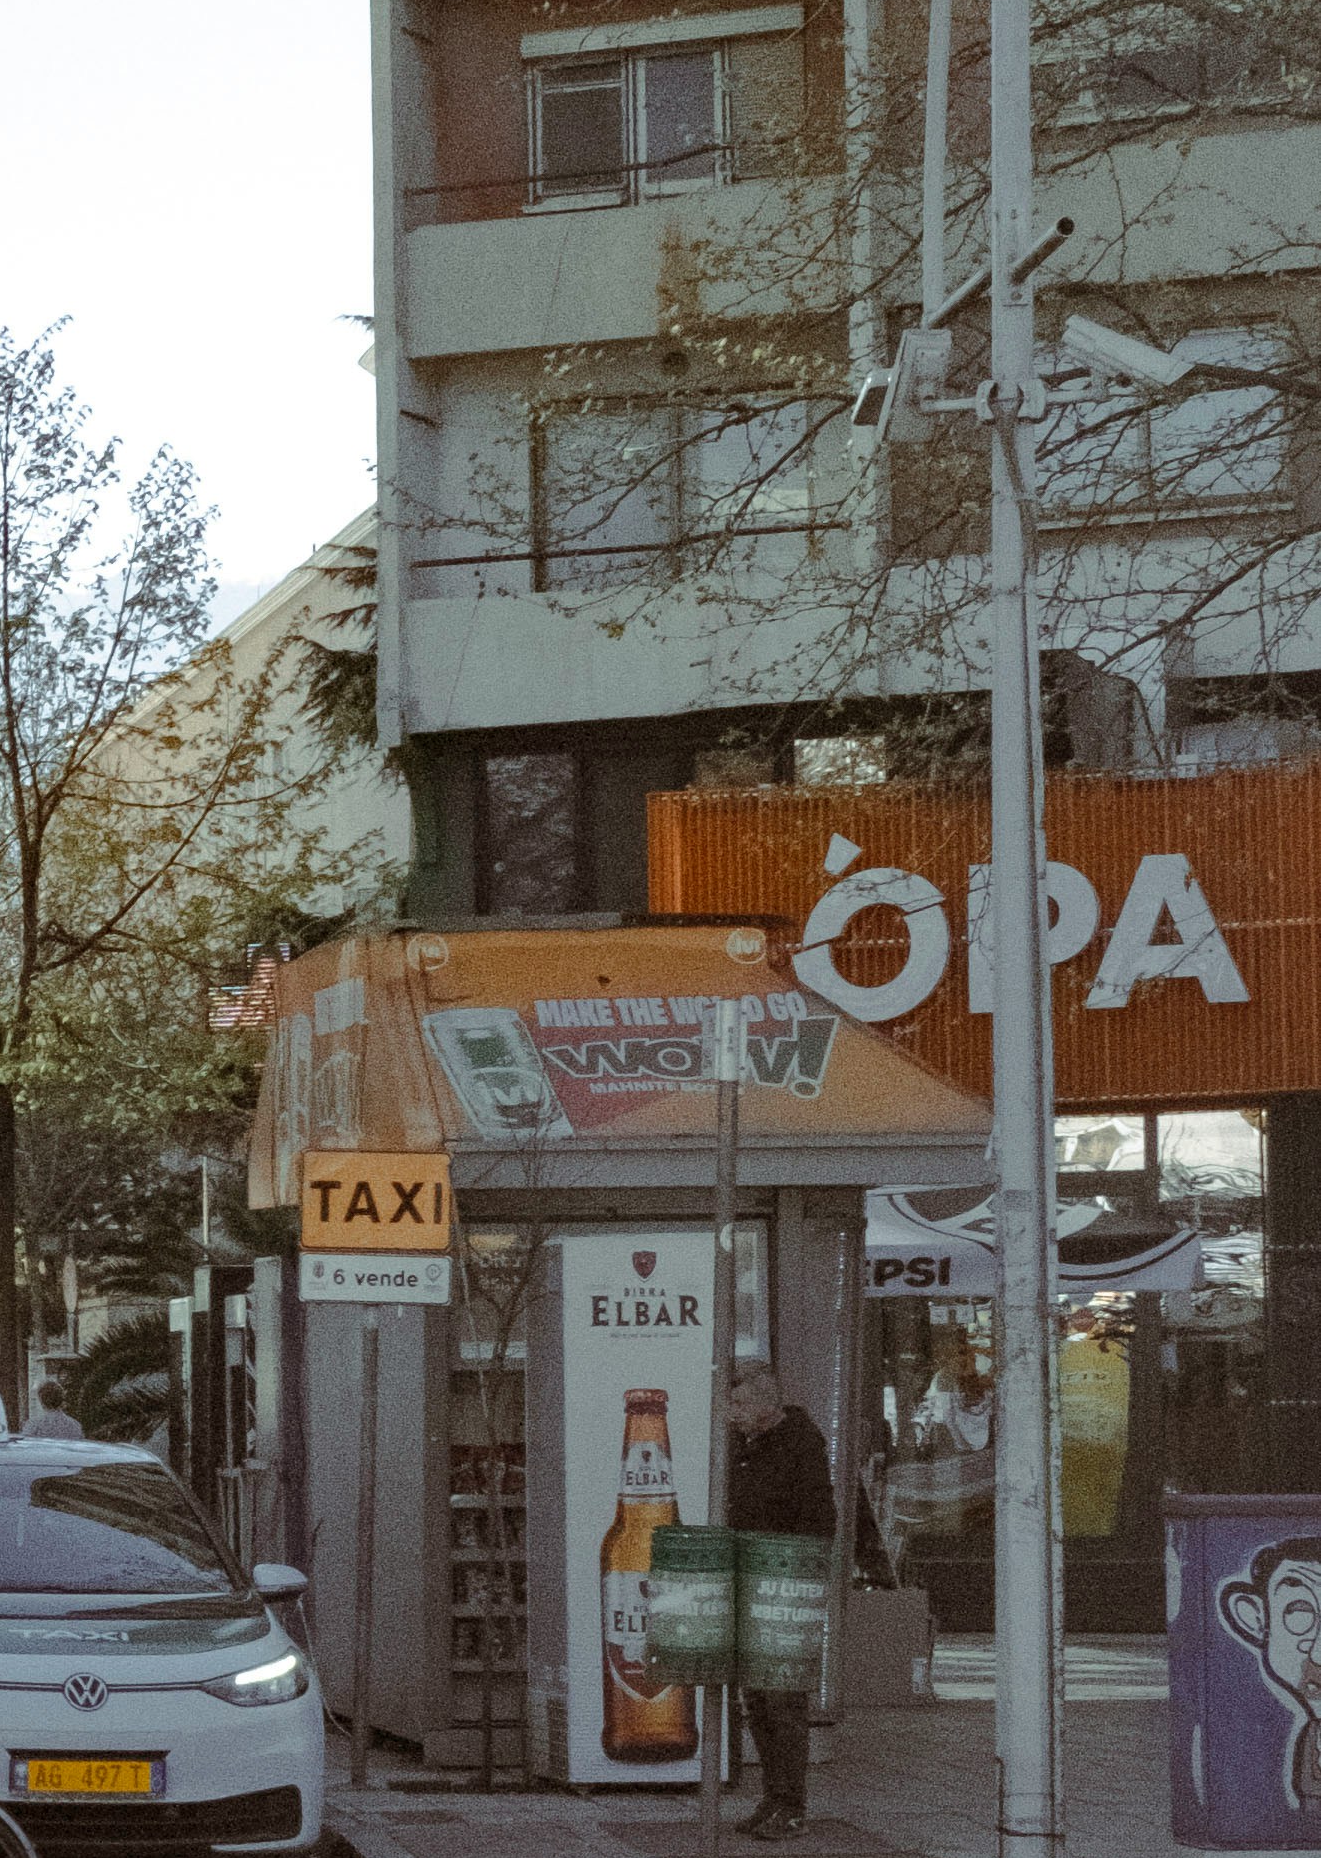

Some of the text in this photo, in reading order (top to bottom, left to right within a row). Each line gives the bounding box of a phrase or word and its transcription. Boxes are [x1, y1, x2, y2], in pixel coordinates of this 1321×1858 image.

[534, 999, 615, 1028] MAKE
[614, 997, 669, 1026] THE
[766, 990, 808, 1020] GO
[310, 1181, 443, 1224] TAXI
[332, 1268, 346, 1286] 6
[355, 1269, 419, 1288] vende
[591, 1295, 702, 1327] ELBAR
[626, 1471, 671, 1486] ELBAR
[9, 1628, 129, 1642] TAXI
[35, 1765, 142, 1788] AG 497 T
